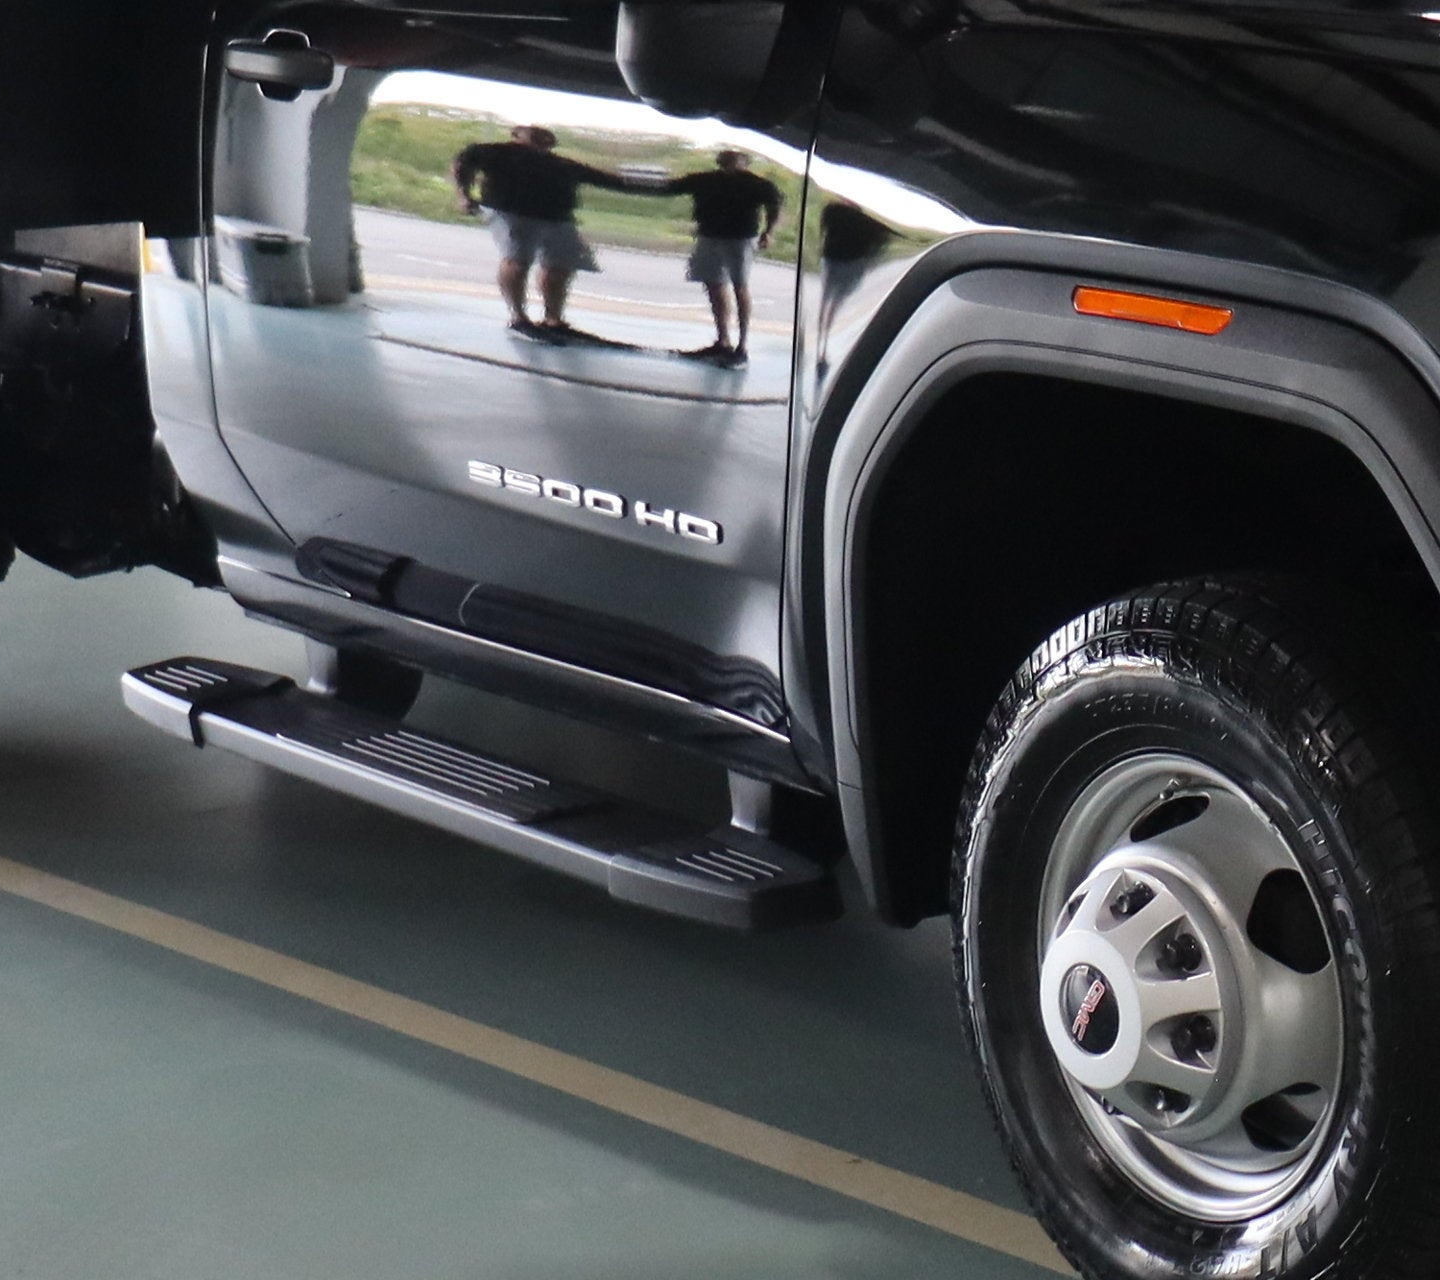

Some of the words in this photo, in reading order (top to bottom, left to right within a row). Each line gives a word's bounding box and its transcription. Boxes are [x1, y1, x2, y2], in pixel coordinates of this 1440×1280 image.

[467, 459, 629, 520] 3500
[633, 500, 725, 545] HD
[1071, 979, 1106, 1042] GMC
